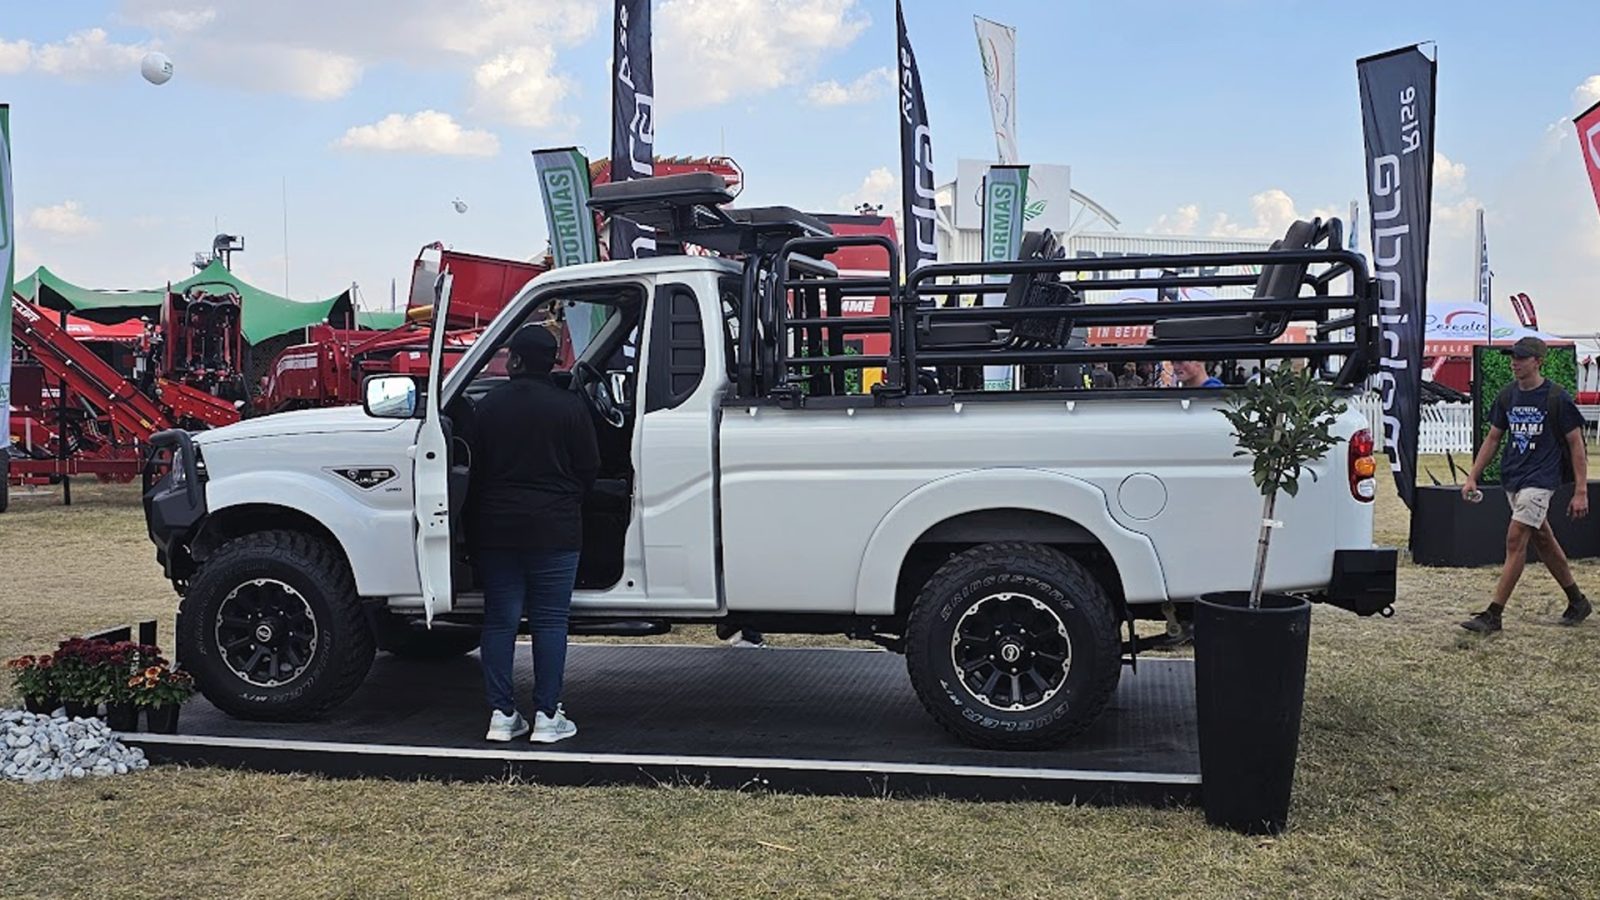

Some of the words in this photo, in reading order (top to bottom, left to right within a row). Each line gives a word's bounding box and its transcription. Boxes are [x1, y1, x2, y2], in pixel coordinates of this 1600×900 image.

[901, 47, 912, 124] Rise
[992, 187, 1012, 258] ORMAS
[1097, 327, 1109, 338] IN
[1115, 326, 1154, 338] BETTE
[1424, 344, 1470, 352] REALIS
